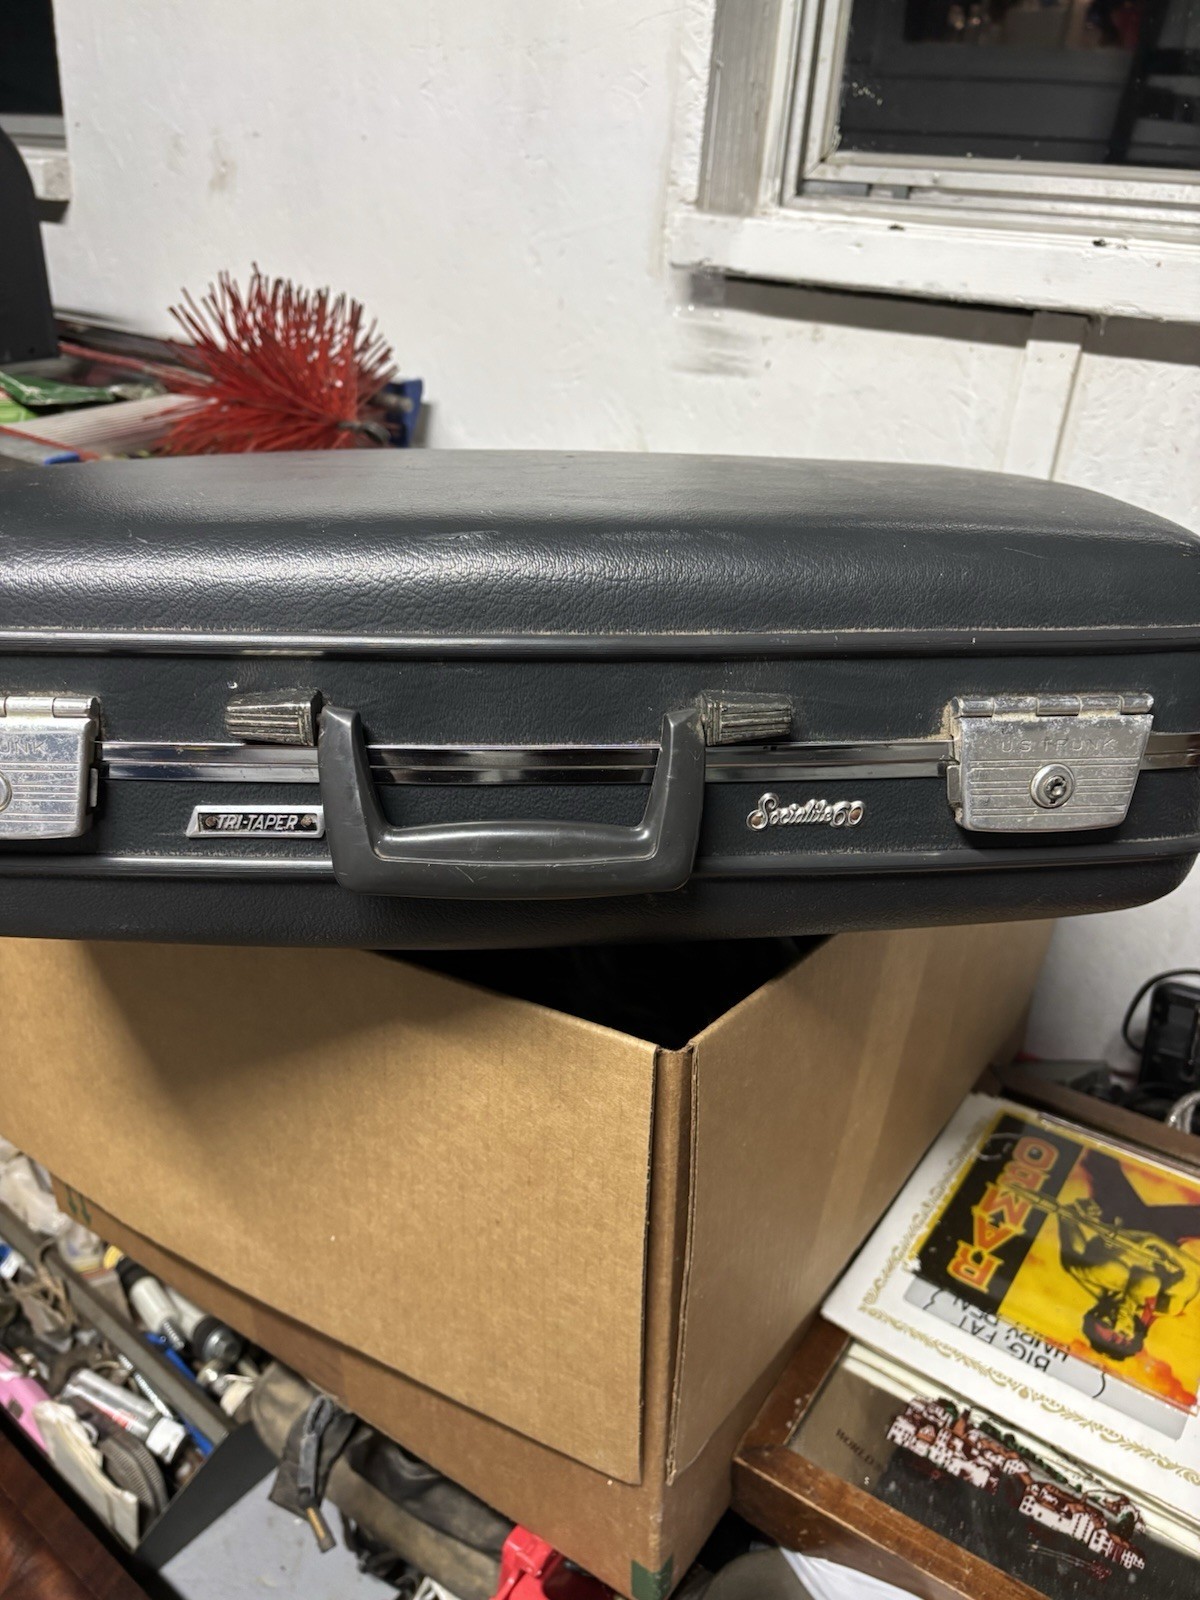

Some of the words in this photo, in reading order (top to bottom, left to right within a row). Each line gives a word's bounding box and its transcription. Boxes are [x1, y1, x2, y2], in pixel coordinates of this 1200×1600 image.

[1042, 736, 1117, 752] TRUNK
[216, 813, 299, 831] TRI-TAPER
[958, 1316, 998, 1346] FAT
